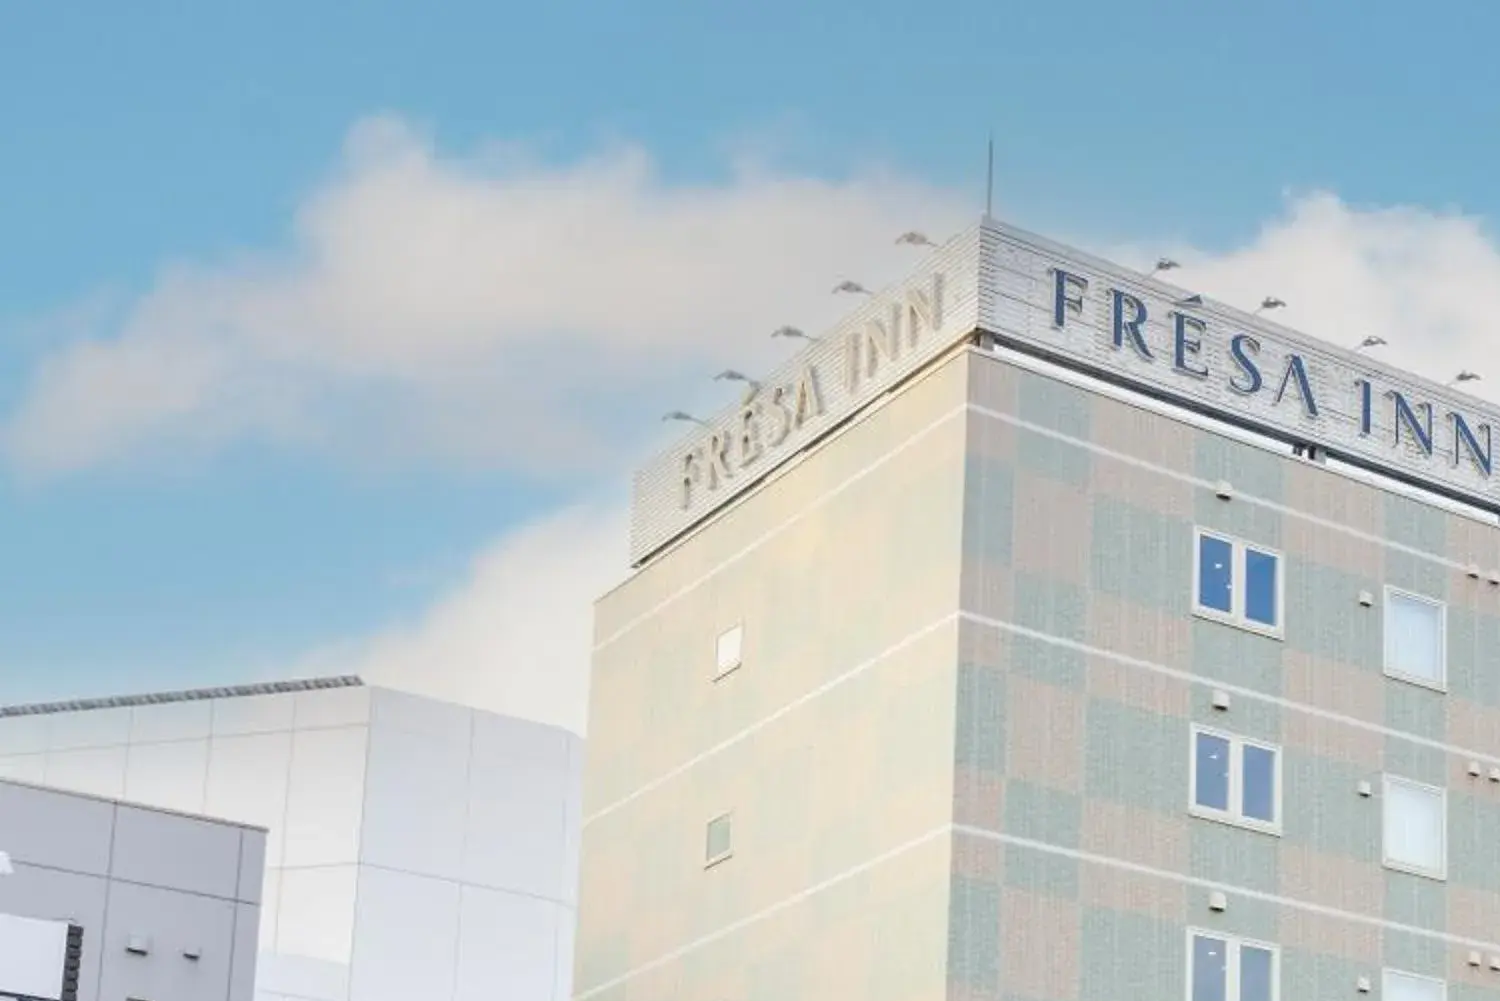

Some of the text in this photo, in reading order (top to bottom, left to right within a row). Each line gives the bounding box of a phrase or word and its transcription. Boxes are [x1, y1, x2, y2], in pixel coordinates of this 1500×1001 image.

[843, 272, 945, 395] INN
[1048, 267, 1492, 479] FRÉSA INN
